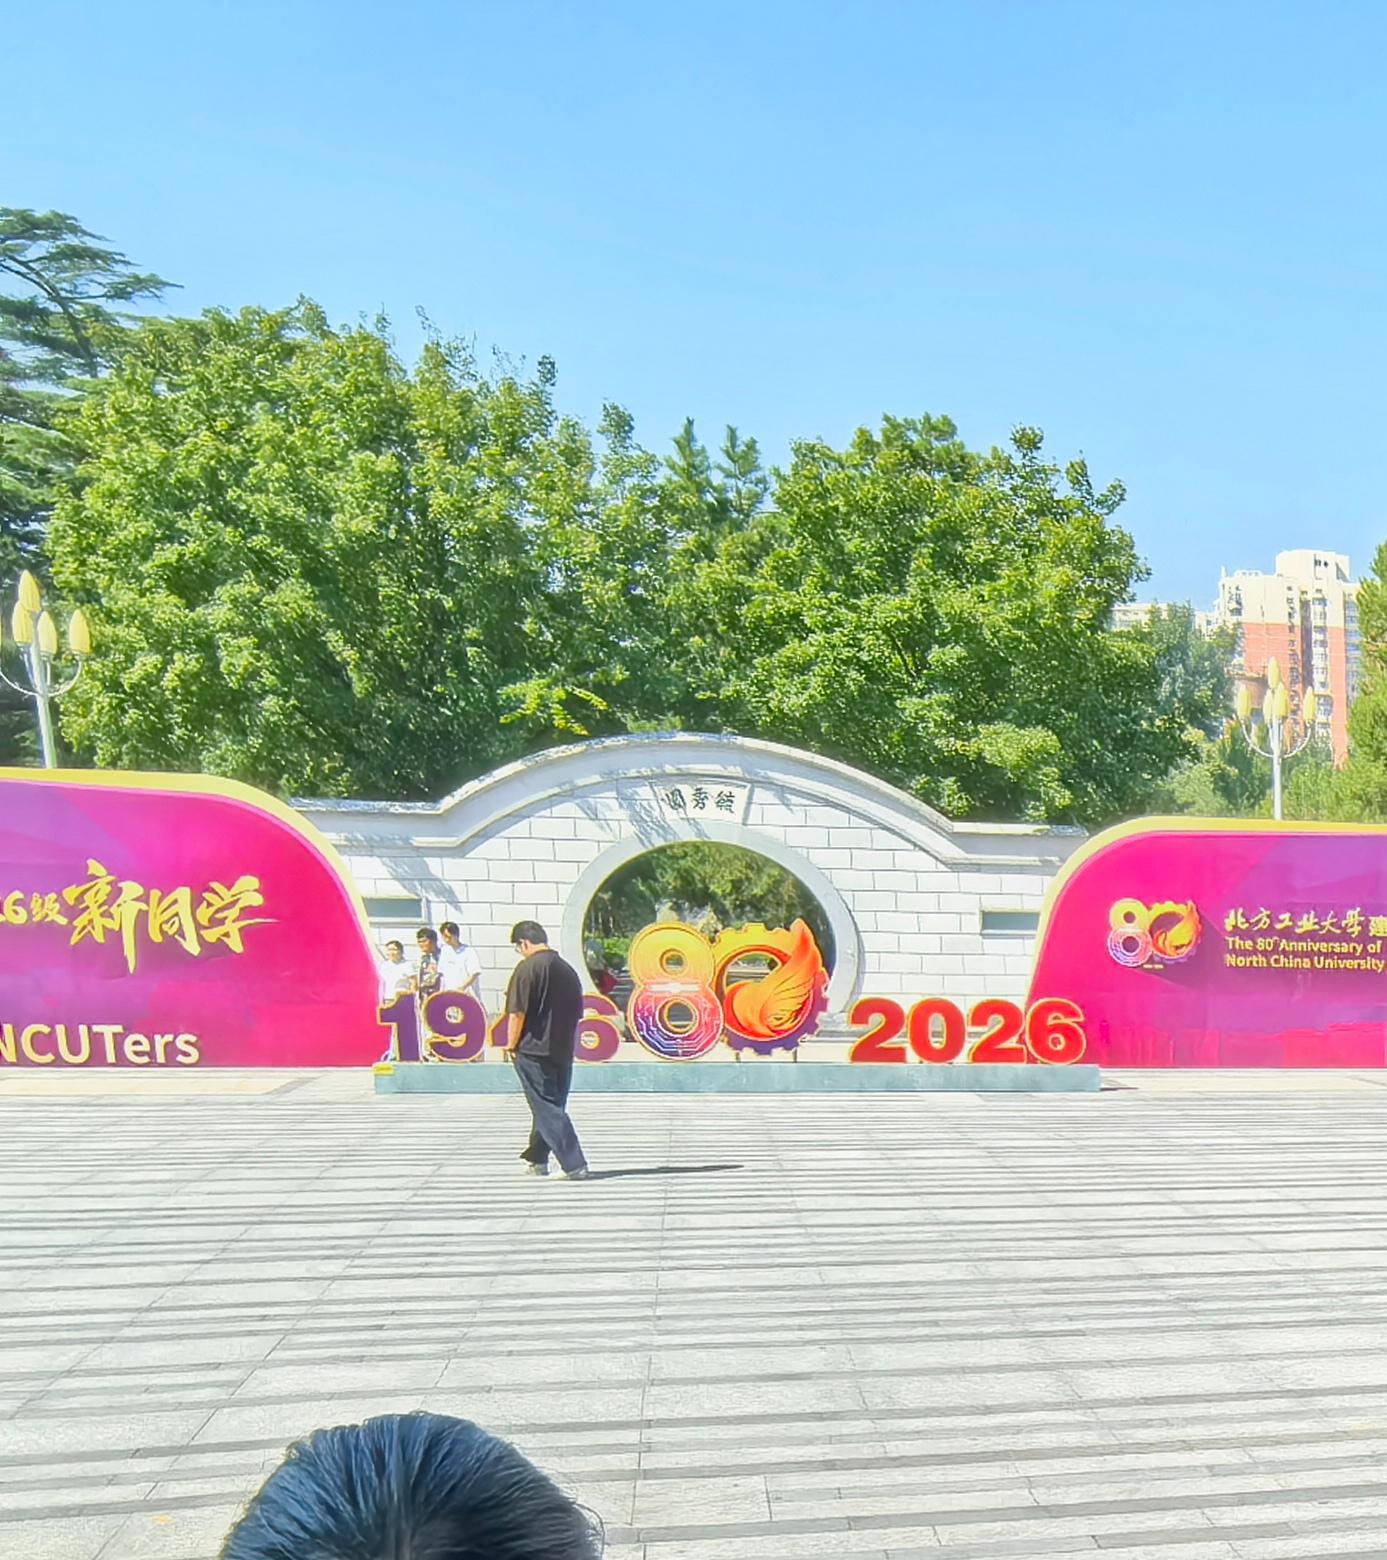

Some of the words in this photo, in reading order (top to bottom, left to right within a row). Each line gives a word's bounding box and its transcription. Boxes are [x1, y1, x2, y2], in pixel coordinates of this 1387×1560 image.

[0, 858, 281, 974] 6级新同学
[1225, 953, 1267, 968] North
[1270, 954, 1311, 969] China
[1313, 955, 1385, 973] University
[1226, 936, 1254, 951] The
[1280, 938, 1363, 955] Anniversary
[1366, 940, 1383, 954] of
[850, 997, 1087, 1065] 2026
